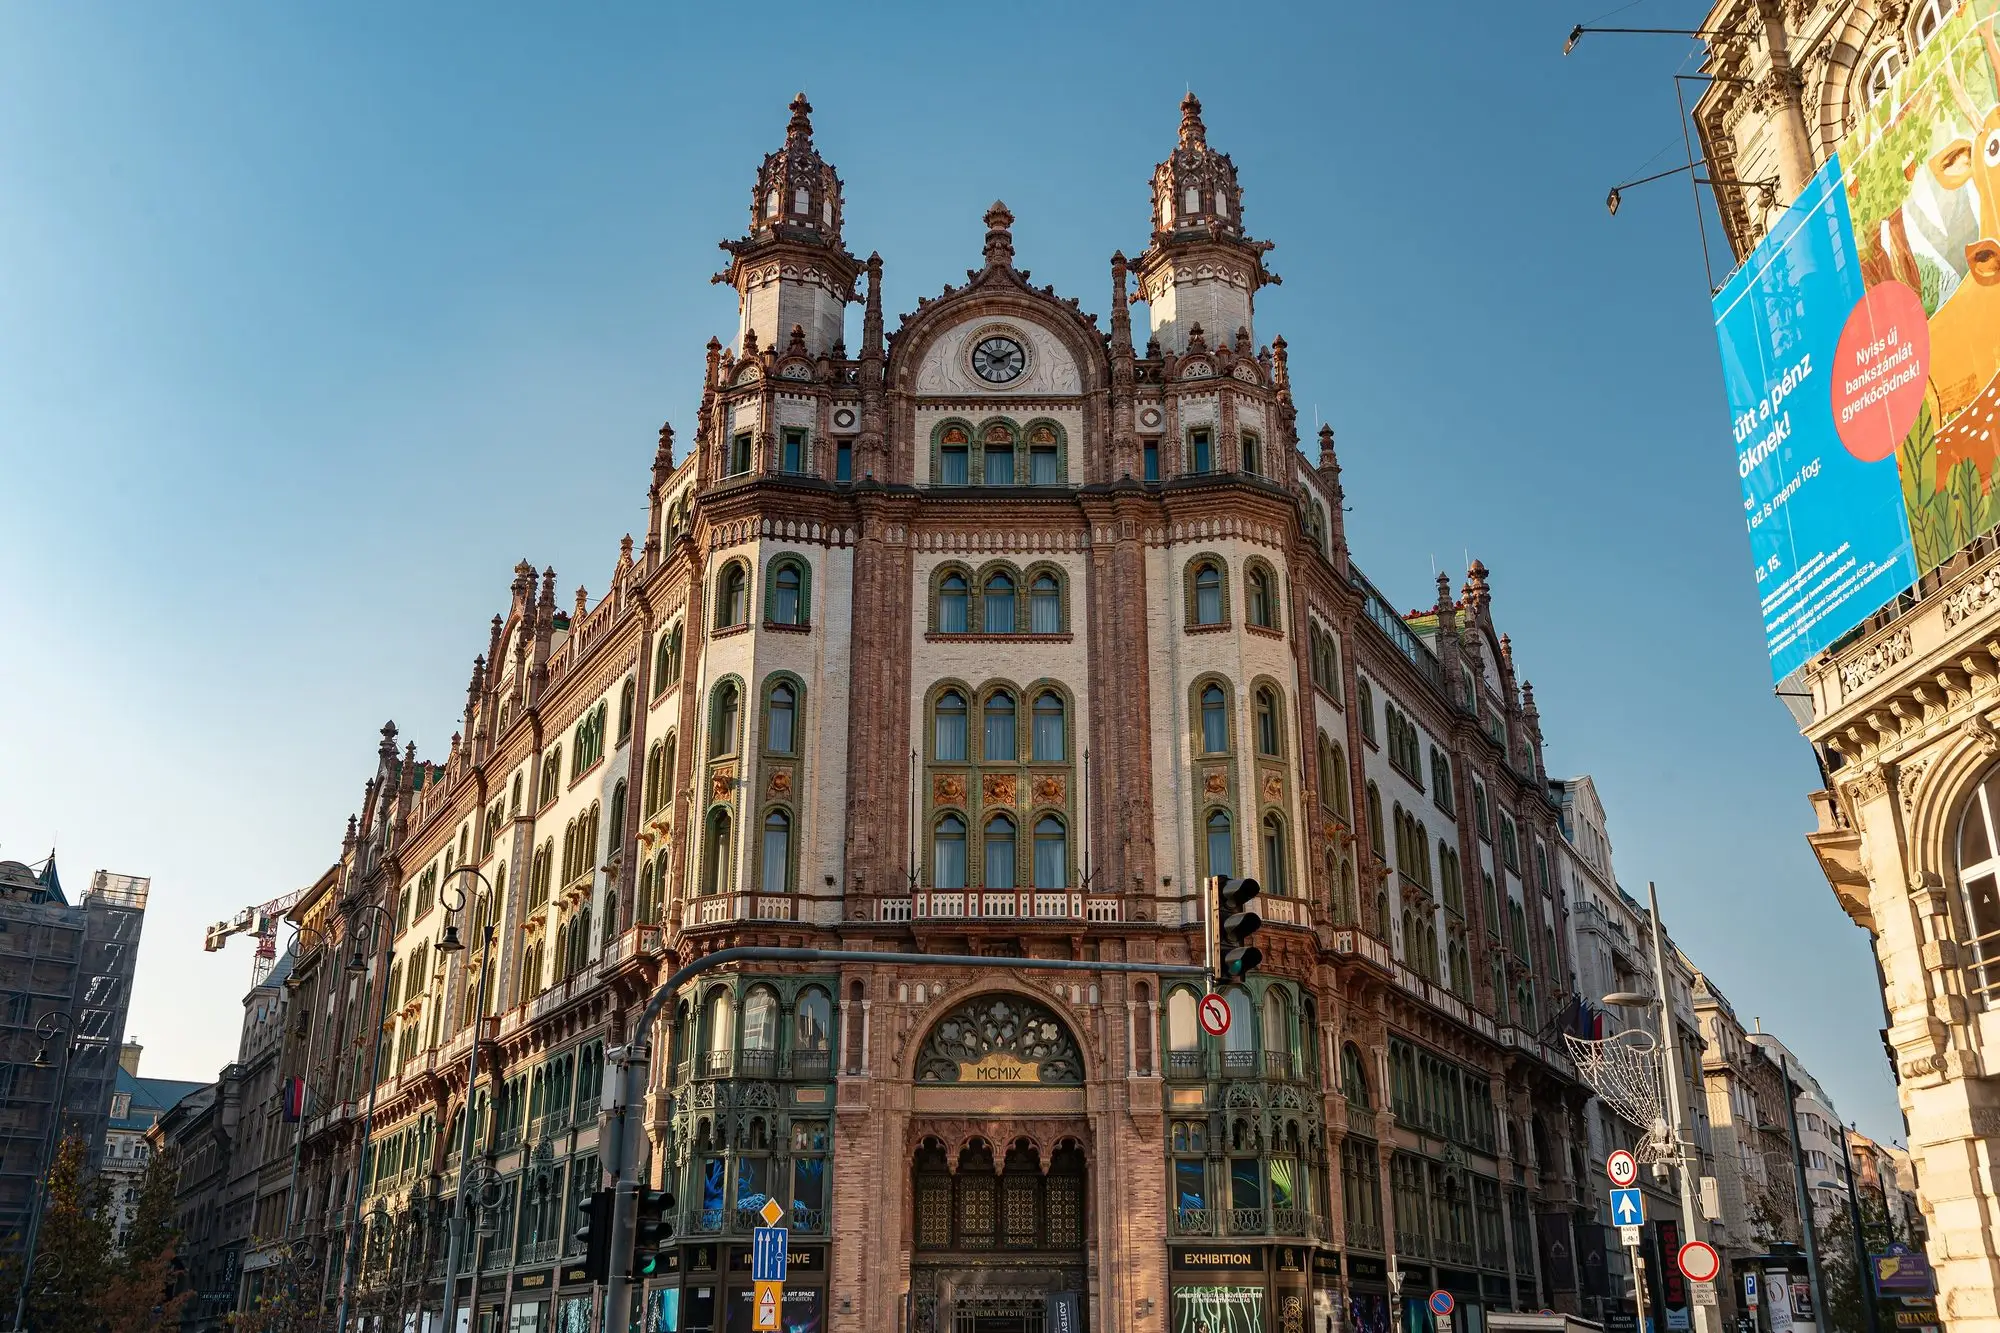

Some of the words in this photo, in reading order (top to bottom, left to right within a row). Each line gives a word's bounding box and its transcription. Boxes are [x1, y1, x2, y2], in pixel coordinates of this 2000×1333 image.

[1856, 338, 1886, 366] Nyiss
[1887, 326, 1898, 346] új
[1845, 341, 1913, 396] bankszámlát
[1733, 407, 1757, 444] ütt
[1759, 399, 1770, 420] a
[1771, 353, 1813, 414] pénz
[1842, 360, 1920, 423] gyerkőcödnek!
[1739, 410, 1791, 478] öknek!
[1751, 510, 1763, 528] ez
[1763, 502, 1772, 518] is
[1772, 472, 1801, 510] menni
[1802, 457, 1821, 482] fog:
[1767, 553, 1781, 573] 15.
[977, 1067, 1021, 1079] MCMIX
[1615, 1162, 1629, 1176] 30
[1185, 1254, 1251, 1264] EXHIBITION
[1898, 1312, 1937, 1324] CHANG
